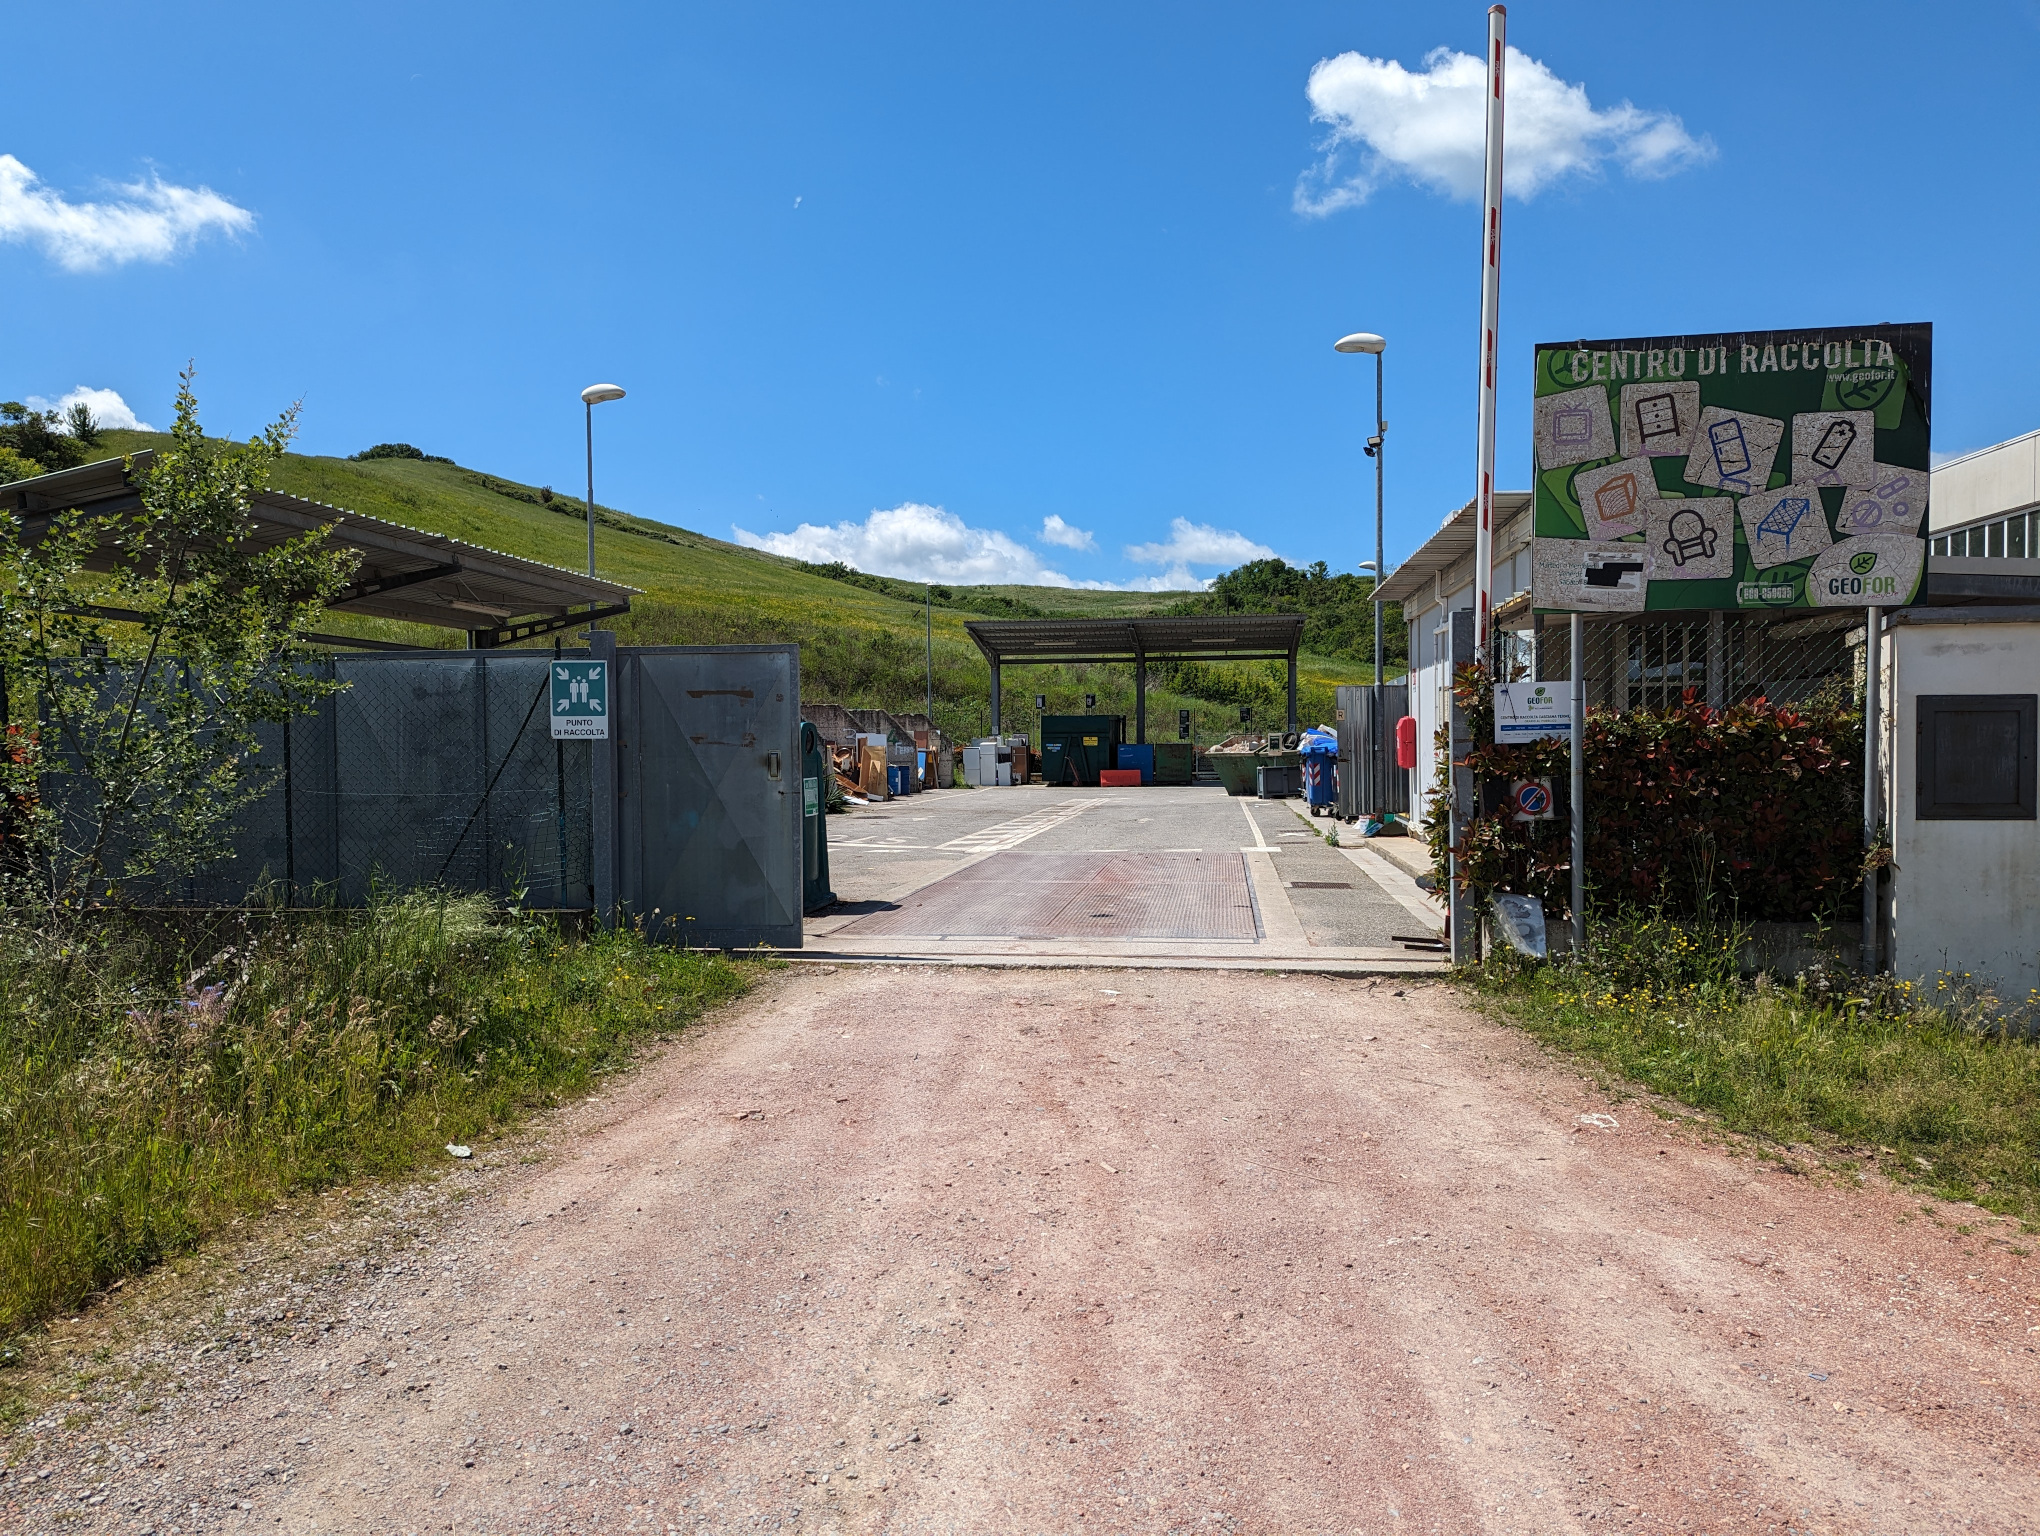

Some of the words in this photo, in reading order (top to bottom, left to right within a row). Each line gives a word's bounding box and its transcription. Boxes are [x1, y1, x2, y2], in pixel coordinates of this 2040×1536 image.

[1571, 348, 1685, 382] CENTRO
[1698, 346, 1727, 375] DI
[1740, 339, 1895, 373] RACCOLTA
[1826, 369, 1895, 384] www.geofor.it
[1829, 576, 1895, 595] GEOFOR
[1867, 591, 1899, 600] recycle
[1338, 711, 1344, 719] R
